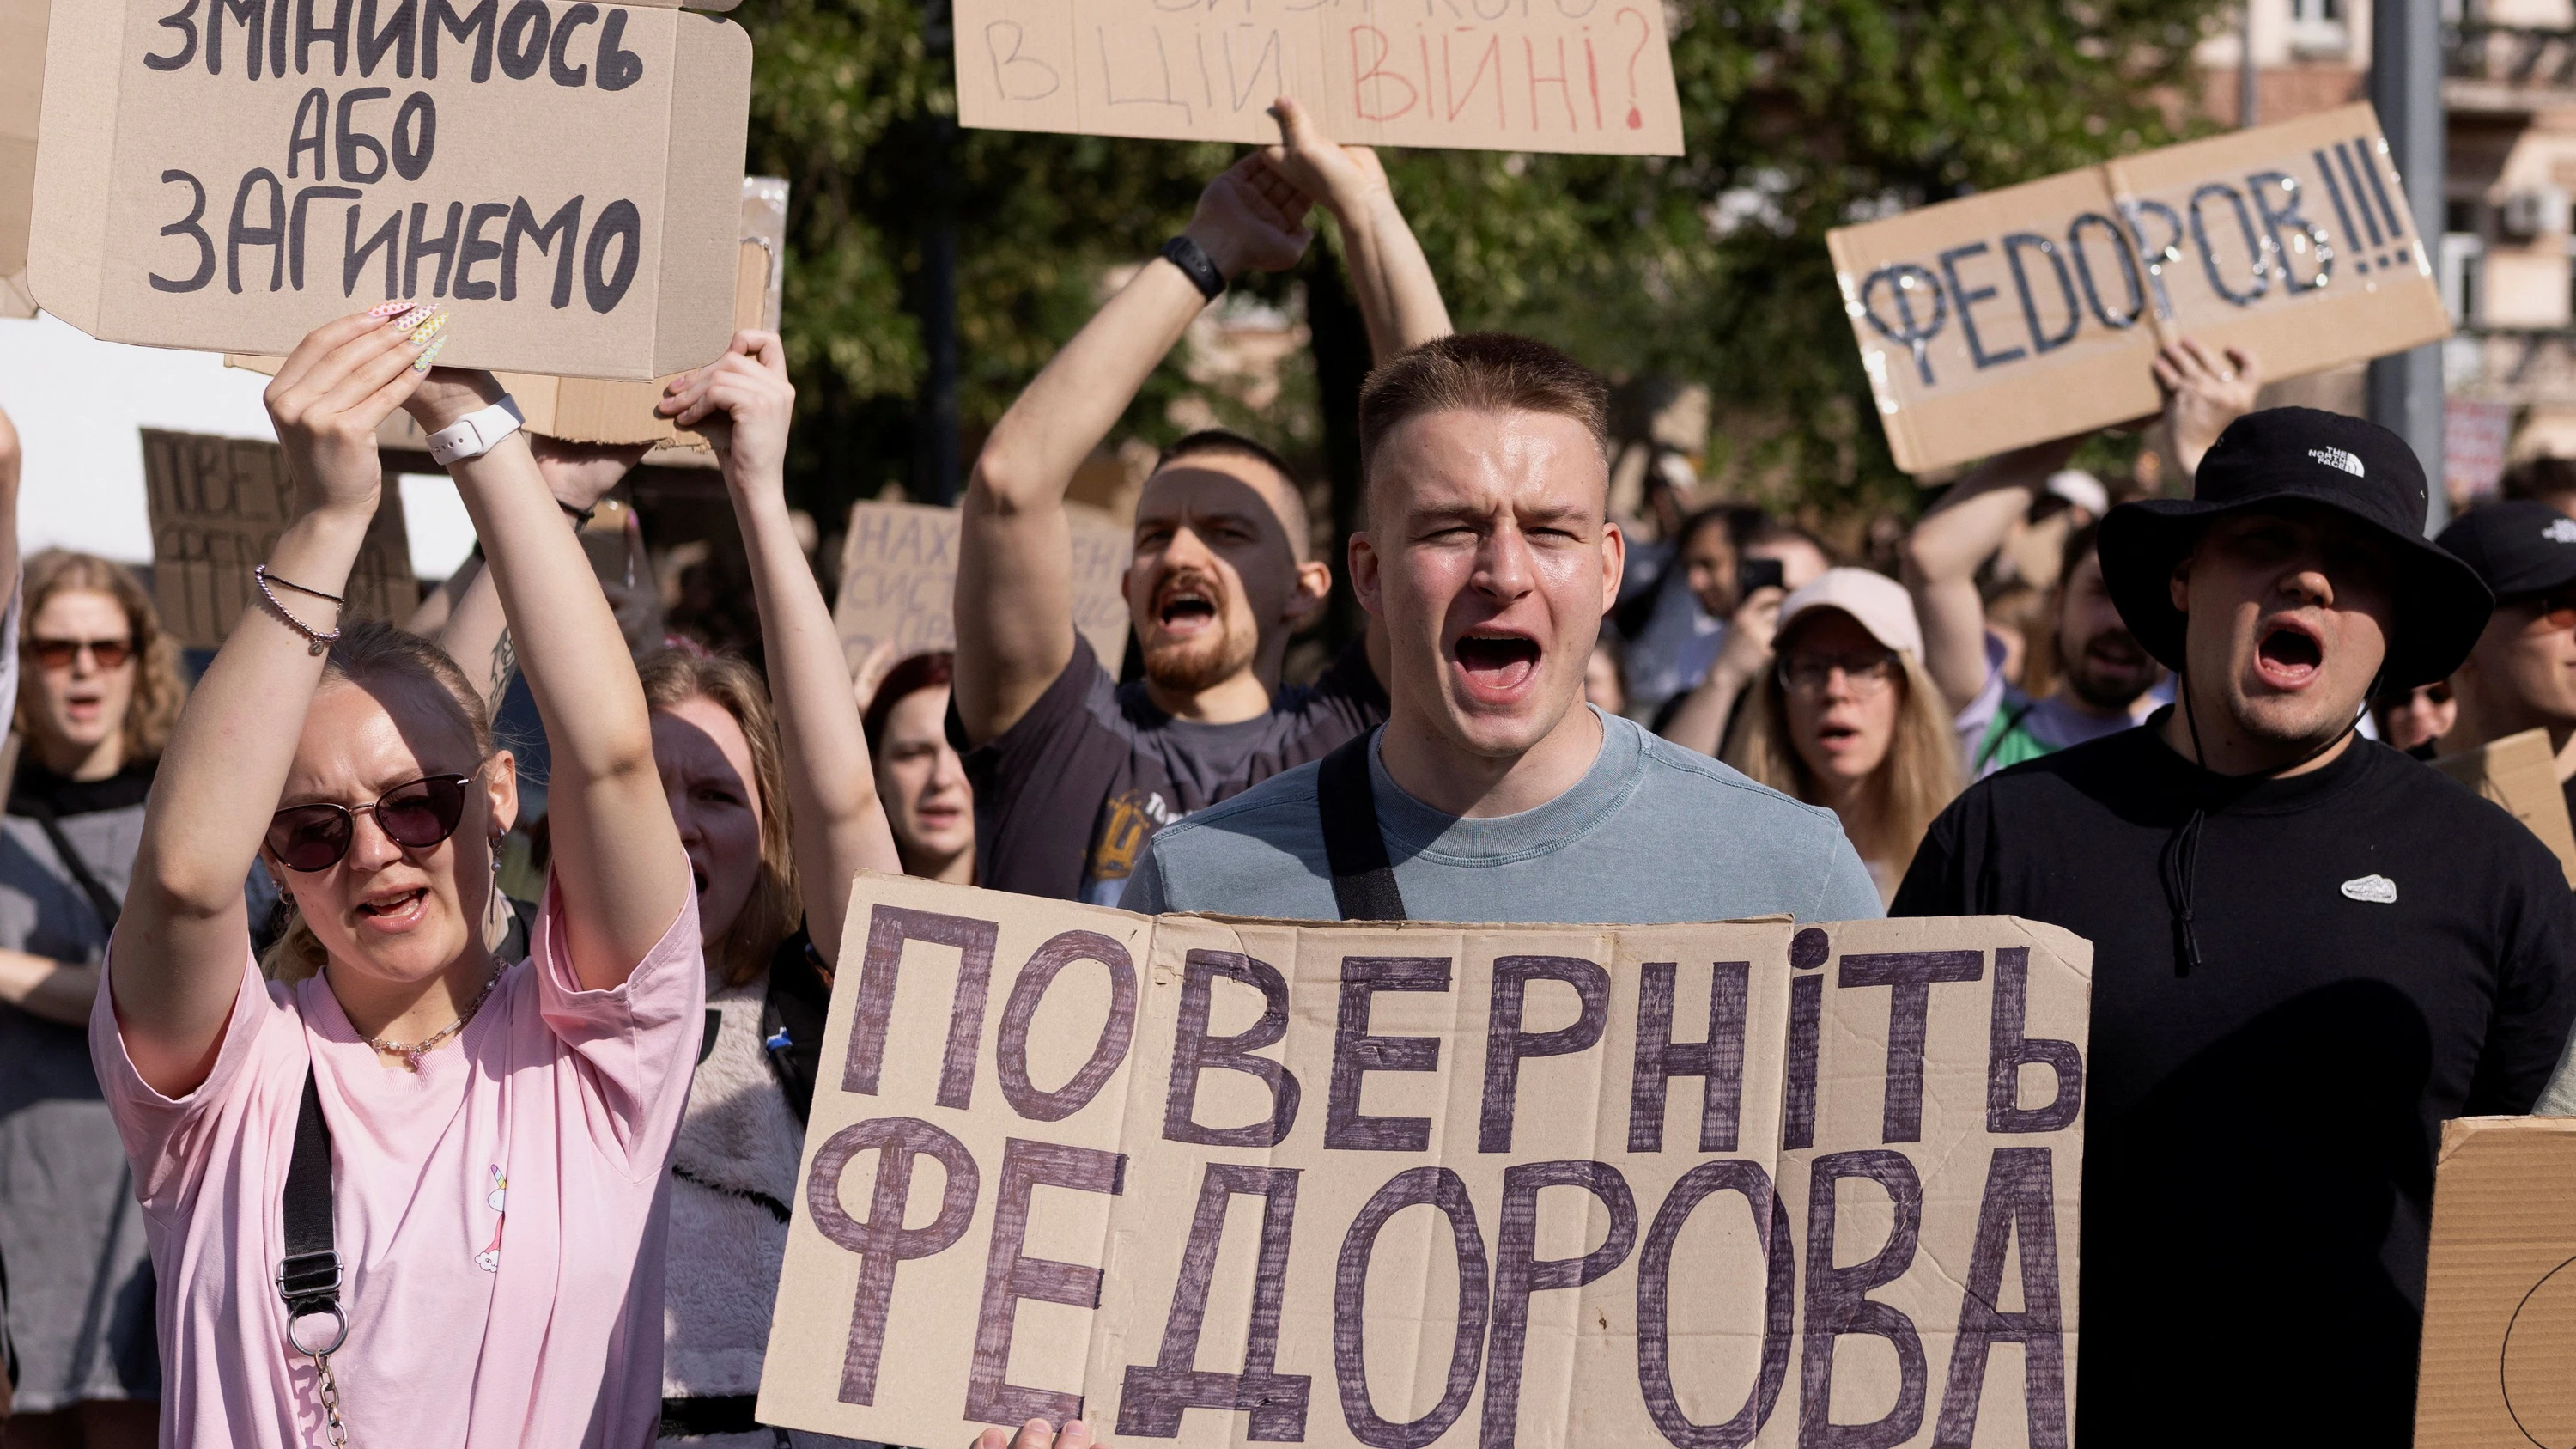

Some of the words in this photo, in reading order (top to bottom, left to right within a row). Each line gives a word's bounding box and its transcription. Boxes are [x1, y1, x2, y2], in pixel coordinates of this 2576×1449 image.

[143, 0, 643, 91] ЗМІНИМОСЬ
[985, 20, 1060, 100] В
[287, 87, 436, 184] АБО
[149, 167, 641, 314] ЗАГИНЕМО
[2308, 448, 2346, 464] NORTH
[2318, 458, 2345, 470] FACE
[2326, 446, 2347, 457] THE
[806, 1117, 2068, 1449] ФЕДОРОВА
